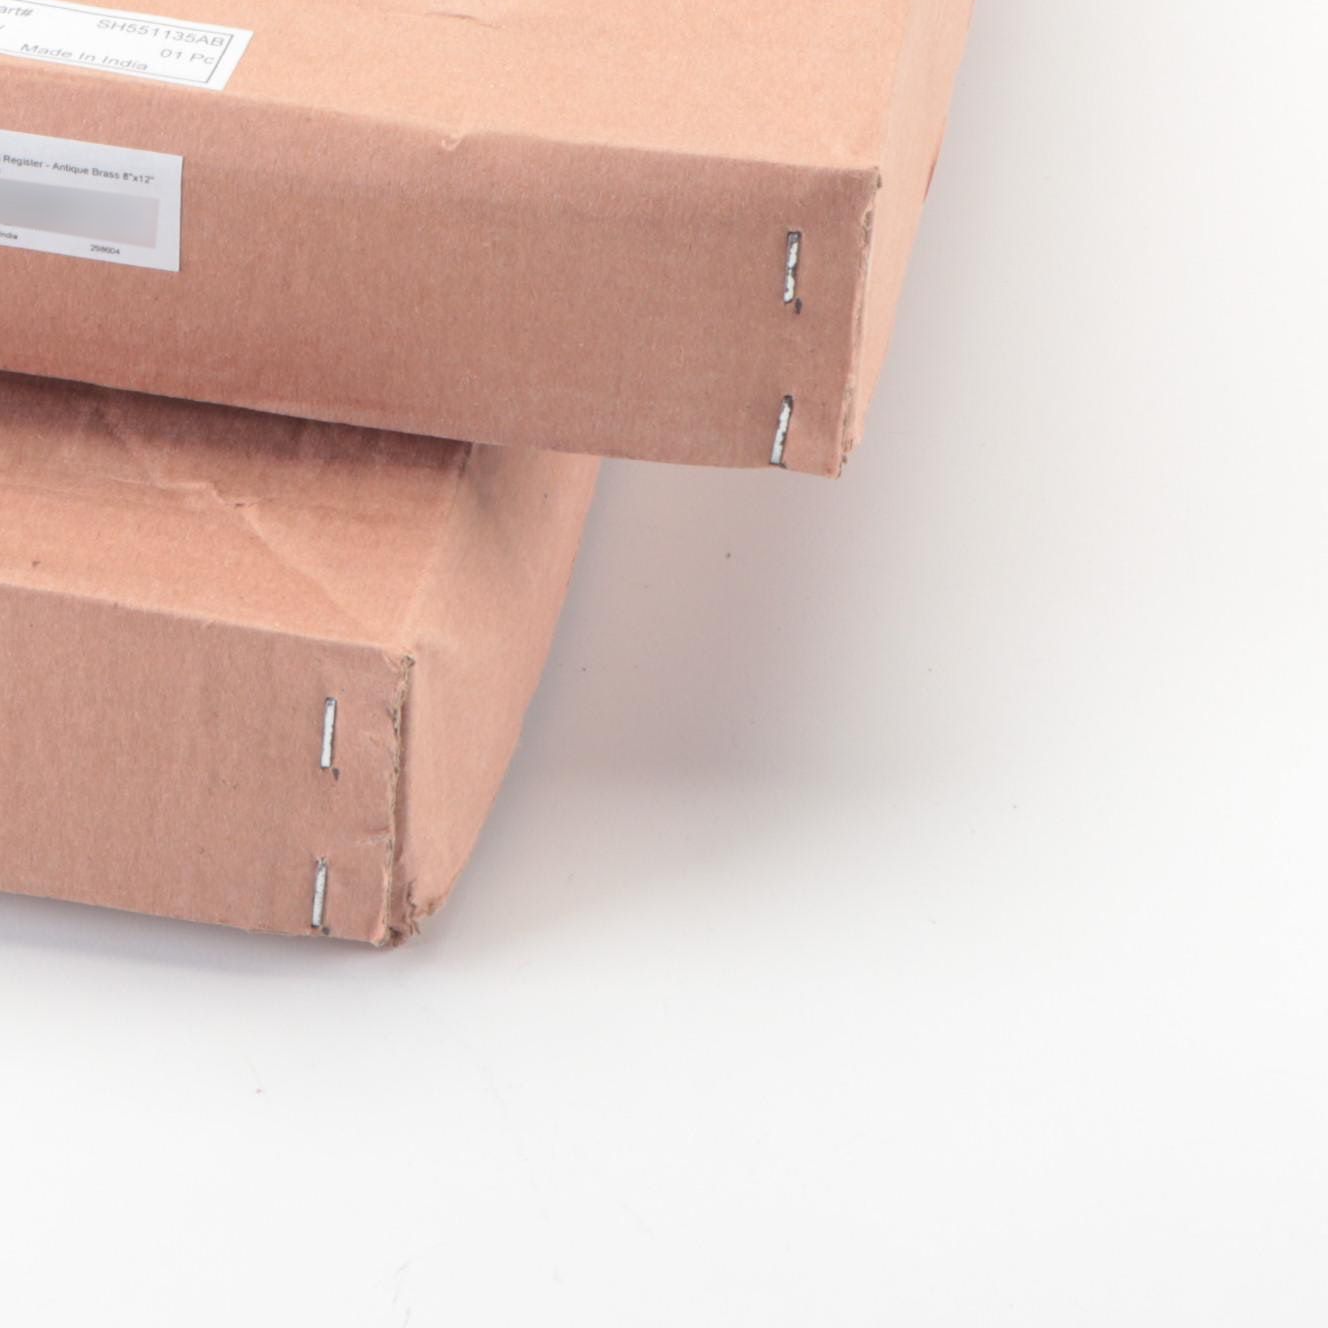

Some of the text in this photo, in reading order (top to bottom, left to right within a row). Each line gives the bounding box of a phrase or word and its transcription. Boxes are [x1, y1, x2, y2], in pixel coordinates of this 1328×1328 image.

[96, 18, 226, 48] SH551135AB
[20, 43, 149, 70] Made In India
[160, 47, 183, 60] 01
[189, 52, 215, 65] Pc
[3, 154, 43, 169] Register
[52, 162, 89, 175] Antique
[92, 167, 120, 179] Brass
